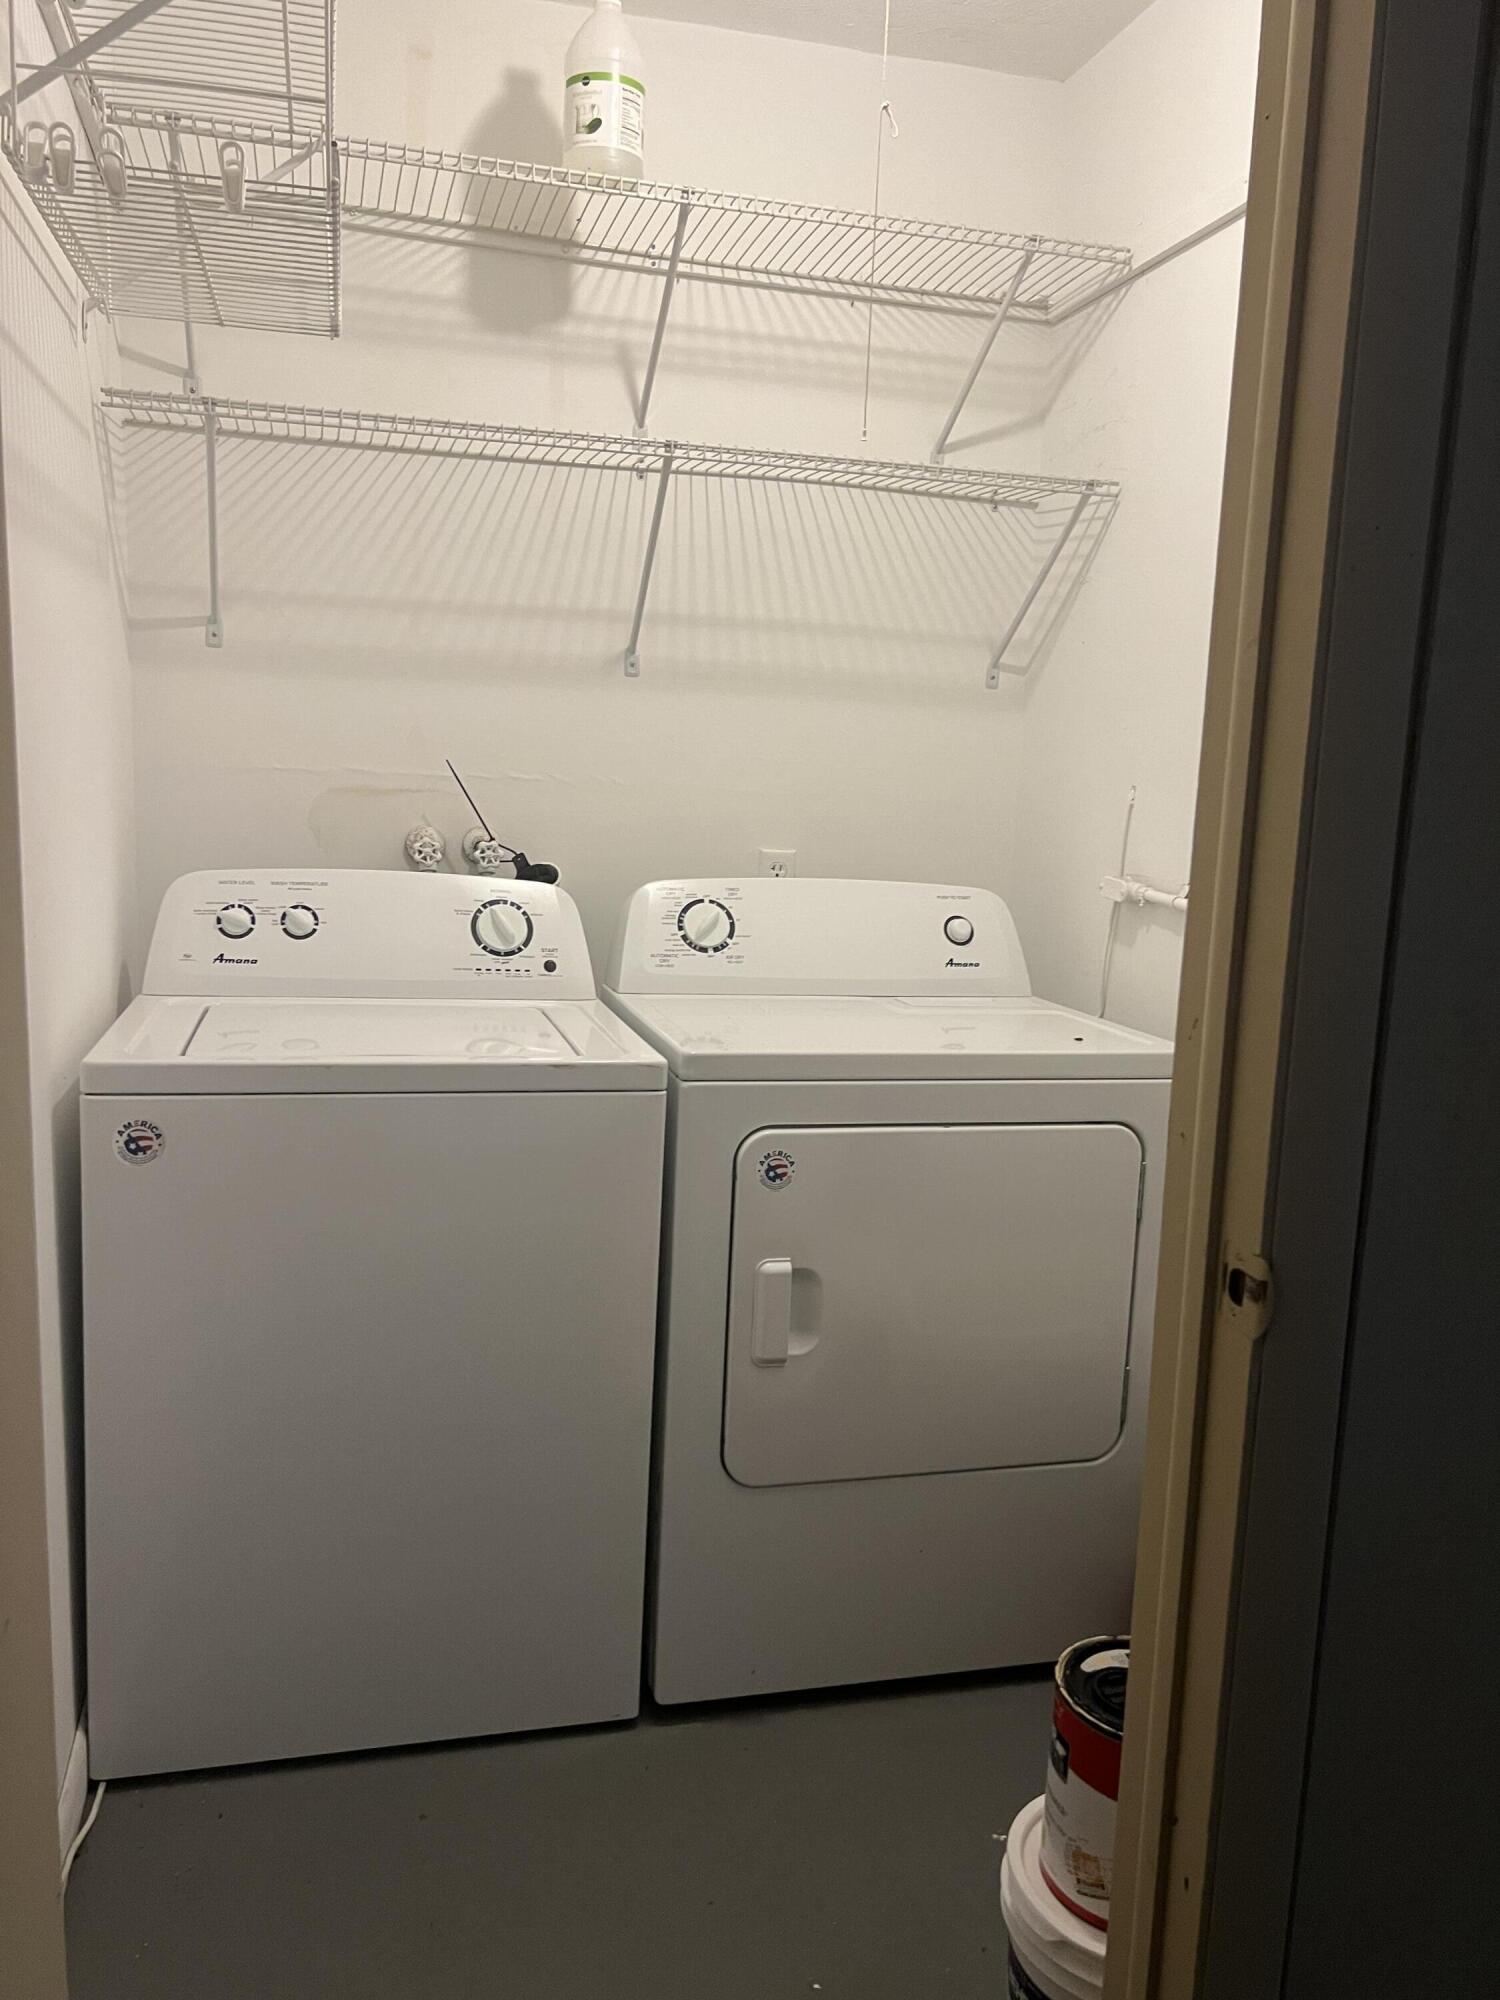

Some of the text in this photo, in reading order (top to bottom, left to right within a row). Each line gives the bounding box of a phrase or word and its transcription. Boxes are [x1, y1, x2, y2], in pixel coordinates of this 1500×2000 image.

[212, 953, 258, 965] Amana
[945, 958, 980, 968] Amana
[117, 1120, 163, 1141] AMERICA
[759, 1150, 796, 1167] AMERICA
